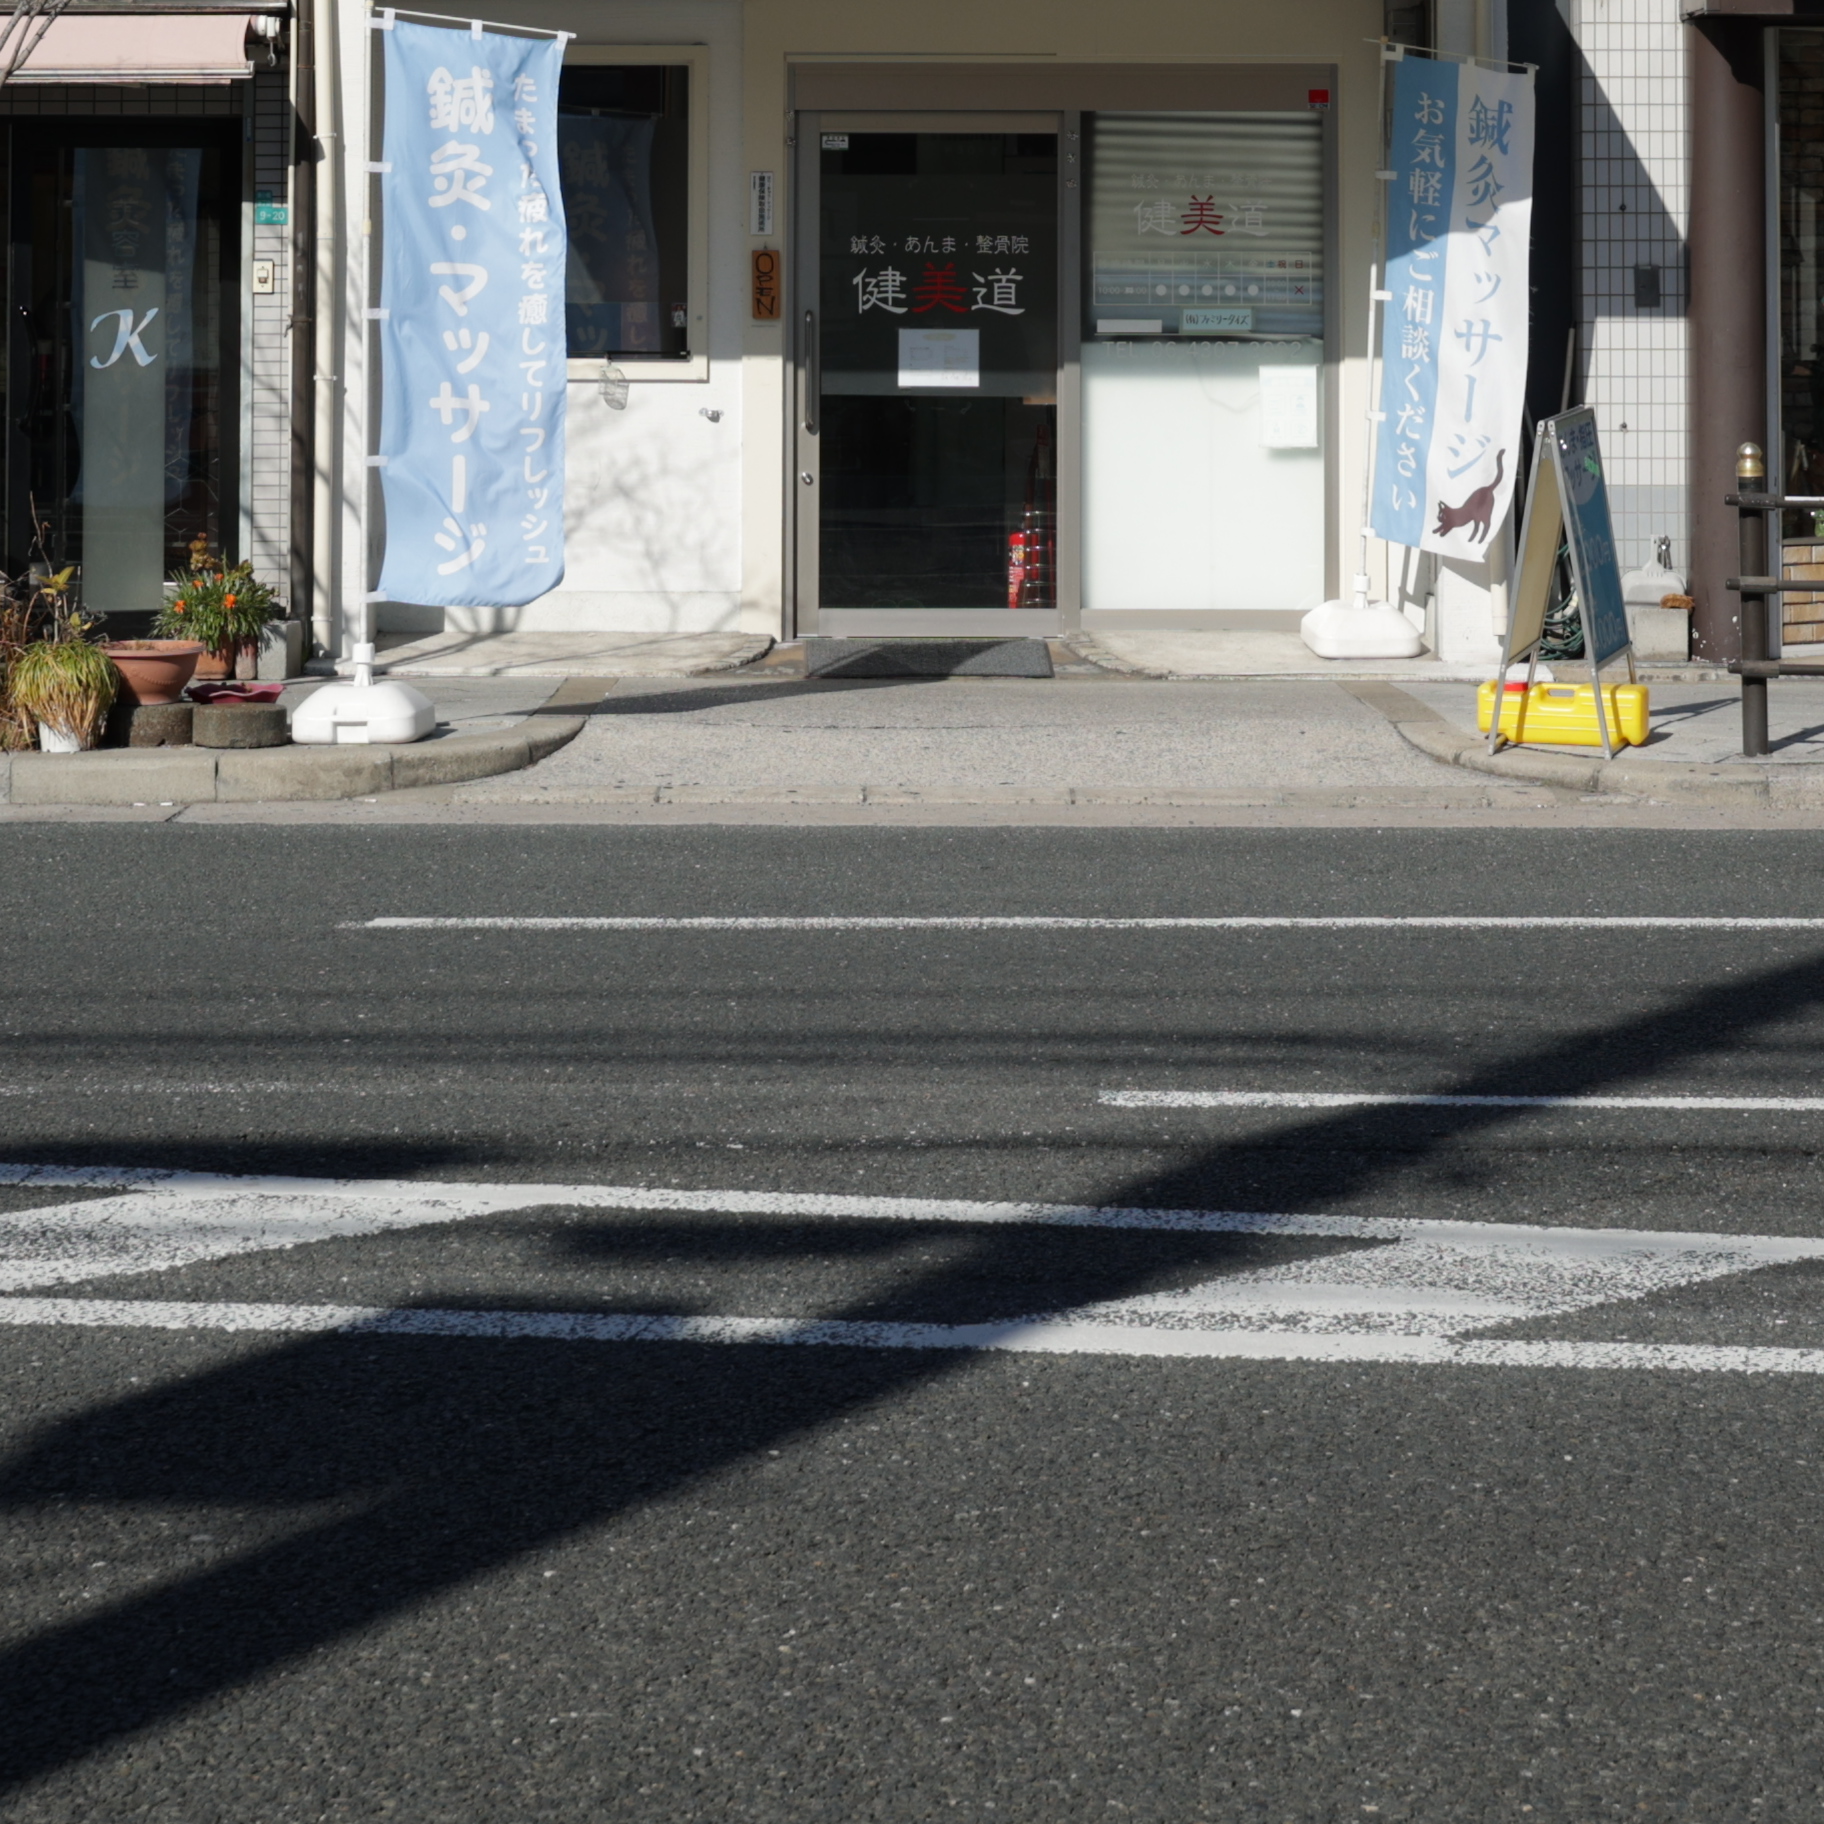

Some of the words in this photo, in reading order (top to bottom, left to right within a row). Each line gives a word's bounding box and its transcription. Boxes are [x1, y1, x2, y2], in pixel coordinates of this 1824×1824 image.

[259, 210, 285, 221] 9-20
[850, 234, 1029, 255] 鍼灸・あんま・整骨院
[1133, 194, 1271, 237] 健美道
[755, 253, 776, 316] OPEN
[852, 262, 1026, 315] 健美道
[1391, 90, 1447, 513] お気軽にご相談ください
[1446, 93, 1514, 480] 鍼灸マッサージ
[90, 307, 160, 370] K
[426, 65, 496, 578] 鍼灸・マッサージ
[513, 72, 550, 566] たまった疲れを癒してリフレッシュ
